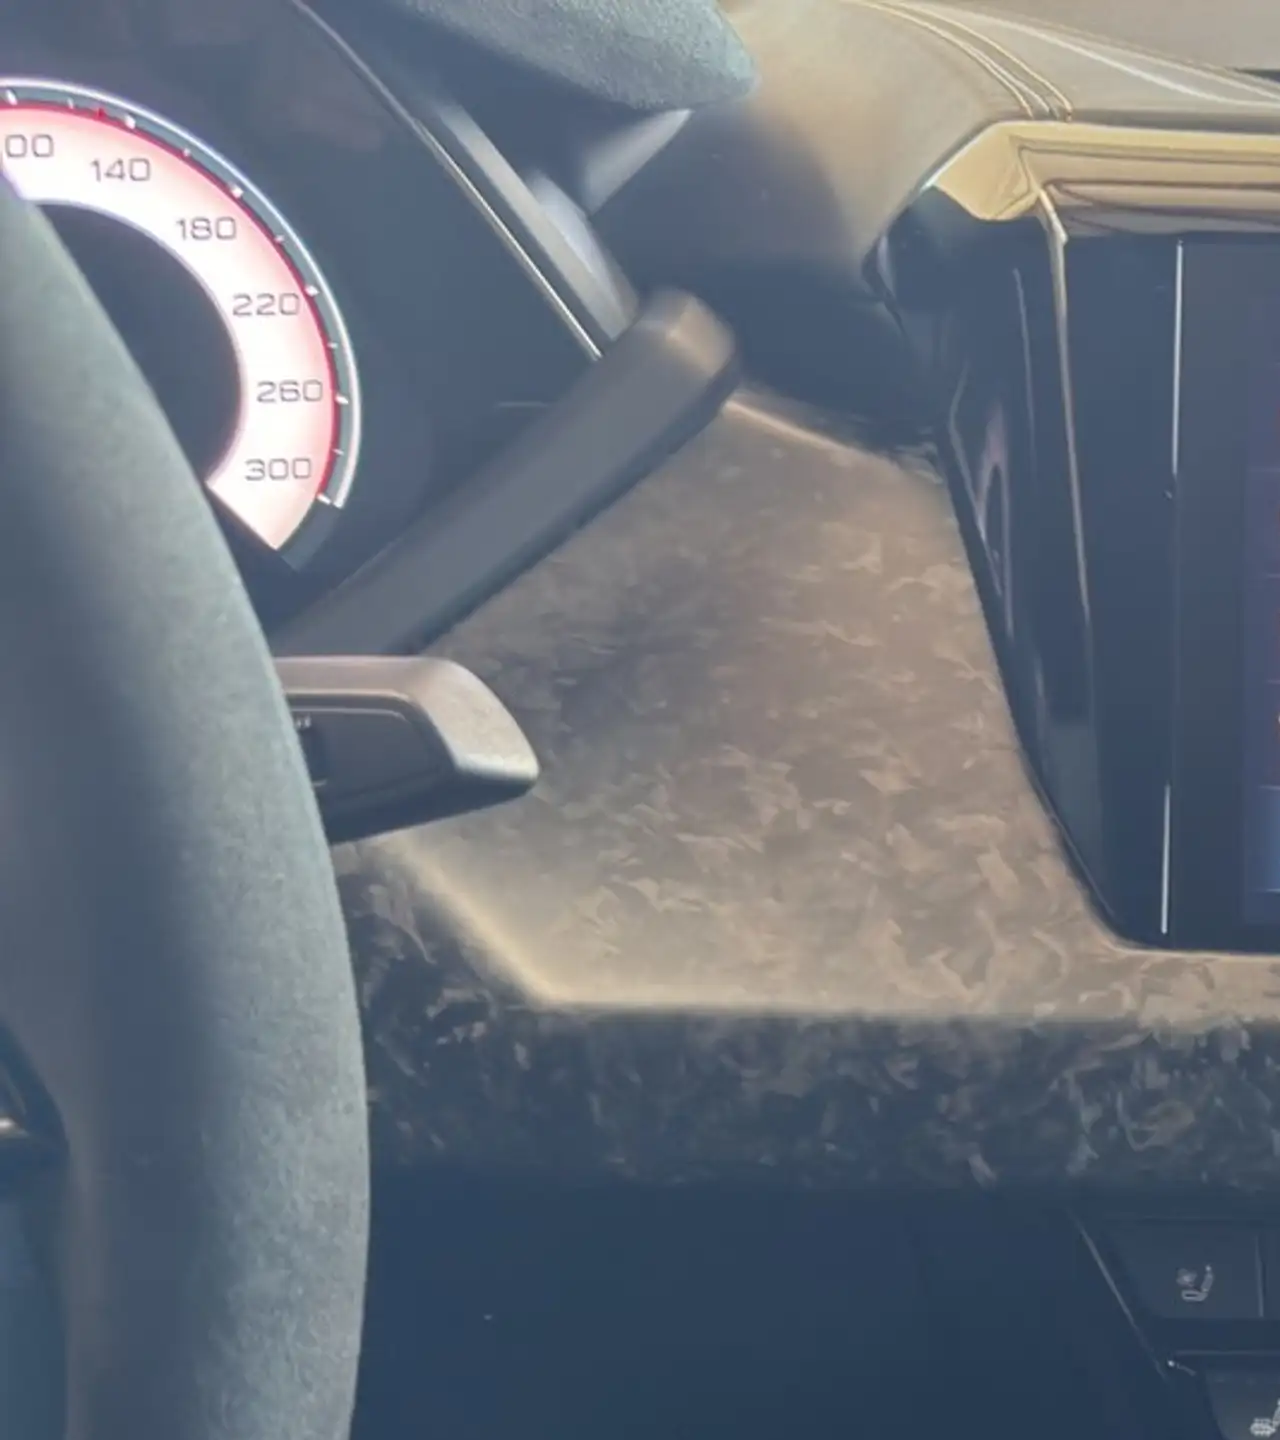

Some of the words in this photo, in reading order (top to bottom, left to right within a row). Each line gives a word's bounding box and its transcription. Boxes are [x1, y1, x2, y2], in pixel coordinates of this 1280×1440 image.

[90, 158, 151, 182] 140
[175, 216, 238, 241] 180
[231, 292, 302, 318] 220
[255, 379, 324, 405] 260
[244, 457, 313, 483] 300
